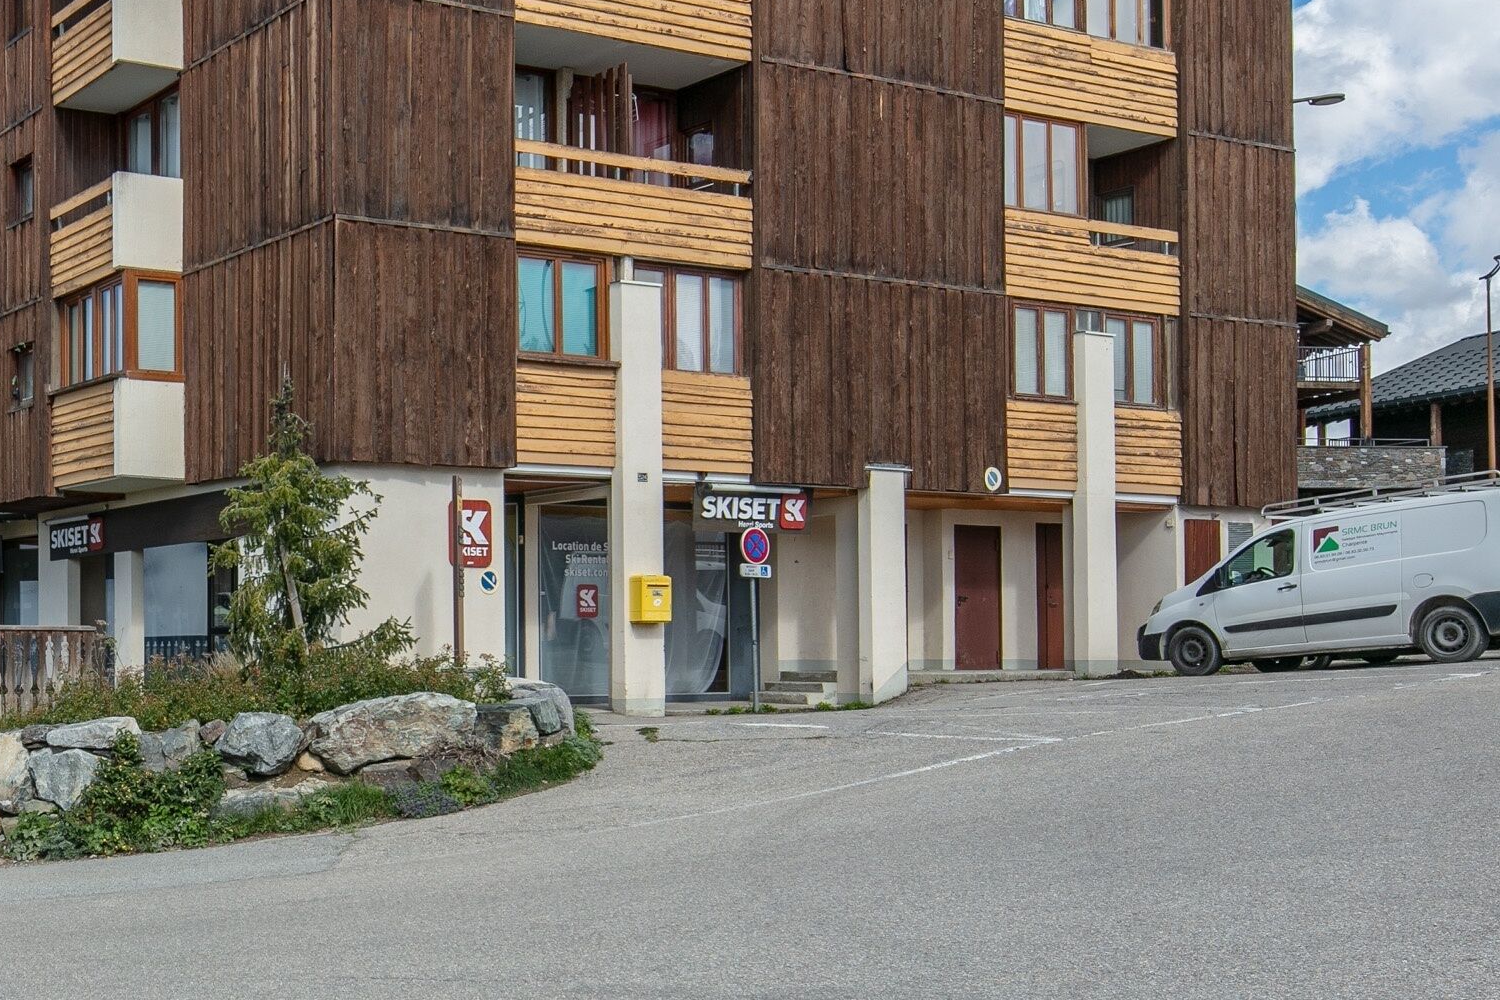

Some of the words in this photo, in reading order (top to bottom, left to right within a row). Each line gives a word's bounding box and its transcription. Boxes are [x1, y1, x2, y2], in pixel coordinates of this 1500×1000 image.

[701, 495, 781, 520] SKISET
[755, 521, 774, 529] Sports
[1341, 525, 1368, 536] SRMC
[1370, 521, 1398, 531] BRUN
[51, 525, 89, 549] SKISET
[462, 547, 488, 557] KISET
[552, 541, 589, 551] Location
[591, 542, 602, 551] de
